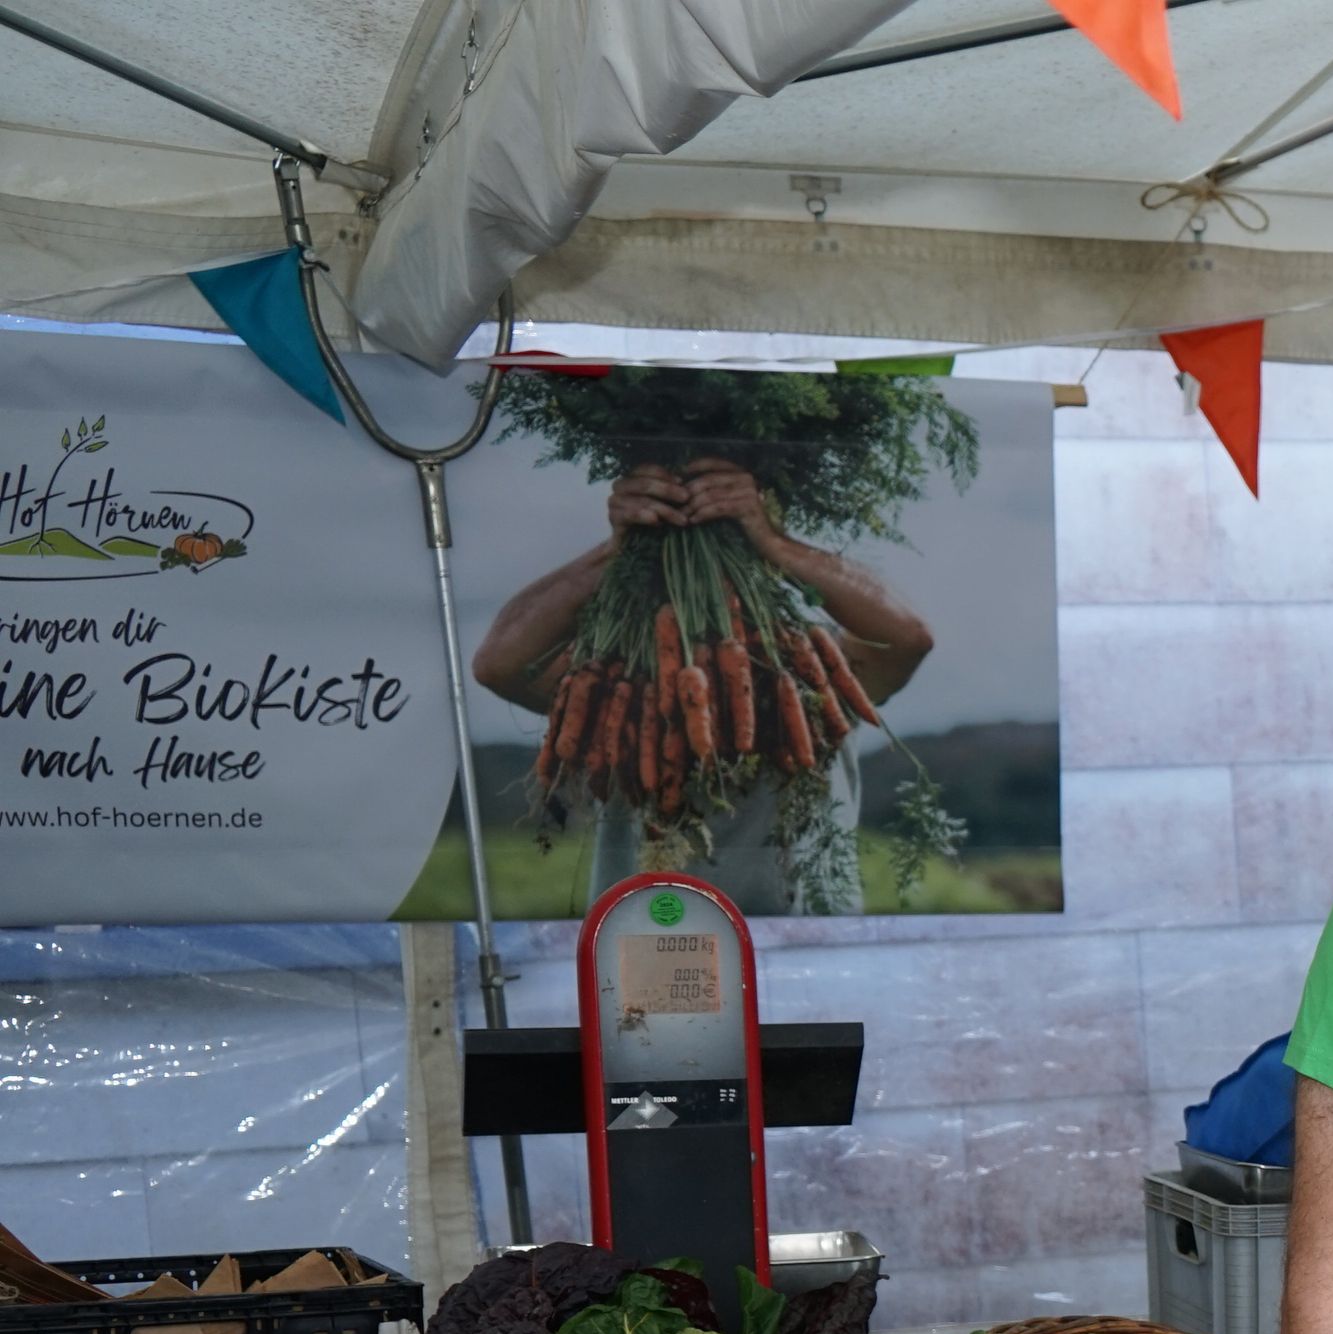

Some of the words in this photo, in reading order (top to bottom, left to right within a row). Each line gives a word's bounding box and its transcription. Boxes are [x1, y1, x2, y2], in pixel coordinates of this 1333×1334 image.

[67, 467, 193, 538] Hörnen
[0, 612, 99, 654] ingen
[111, 607, 167, 647] dir
[20, 736, 113, 783] nach
[133, 735, 266, 790] Hause
